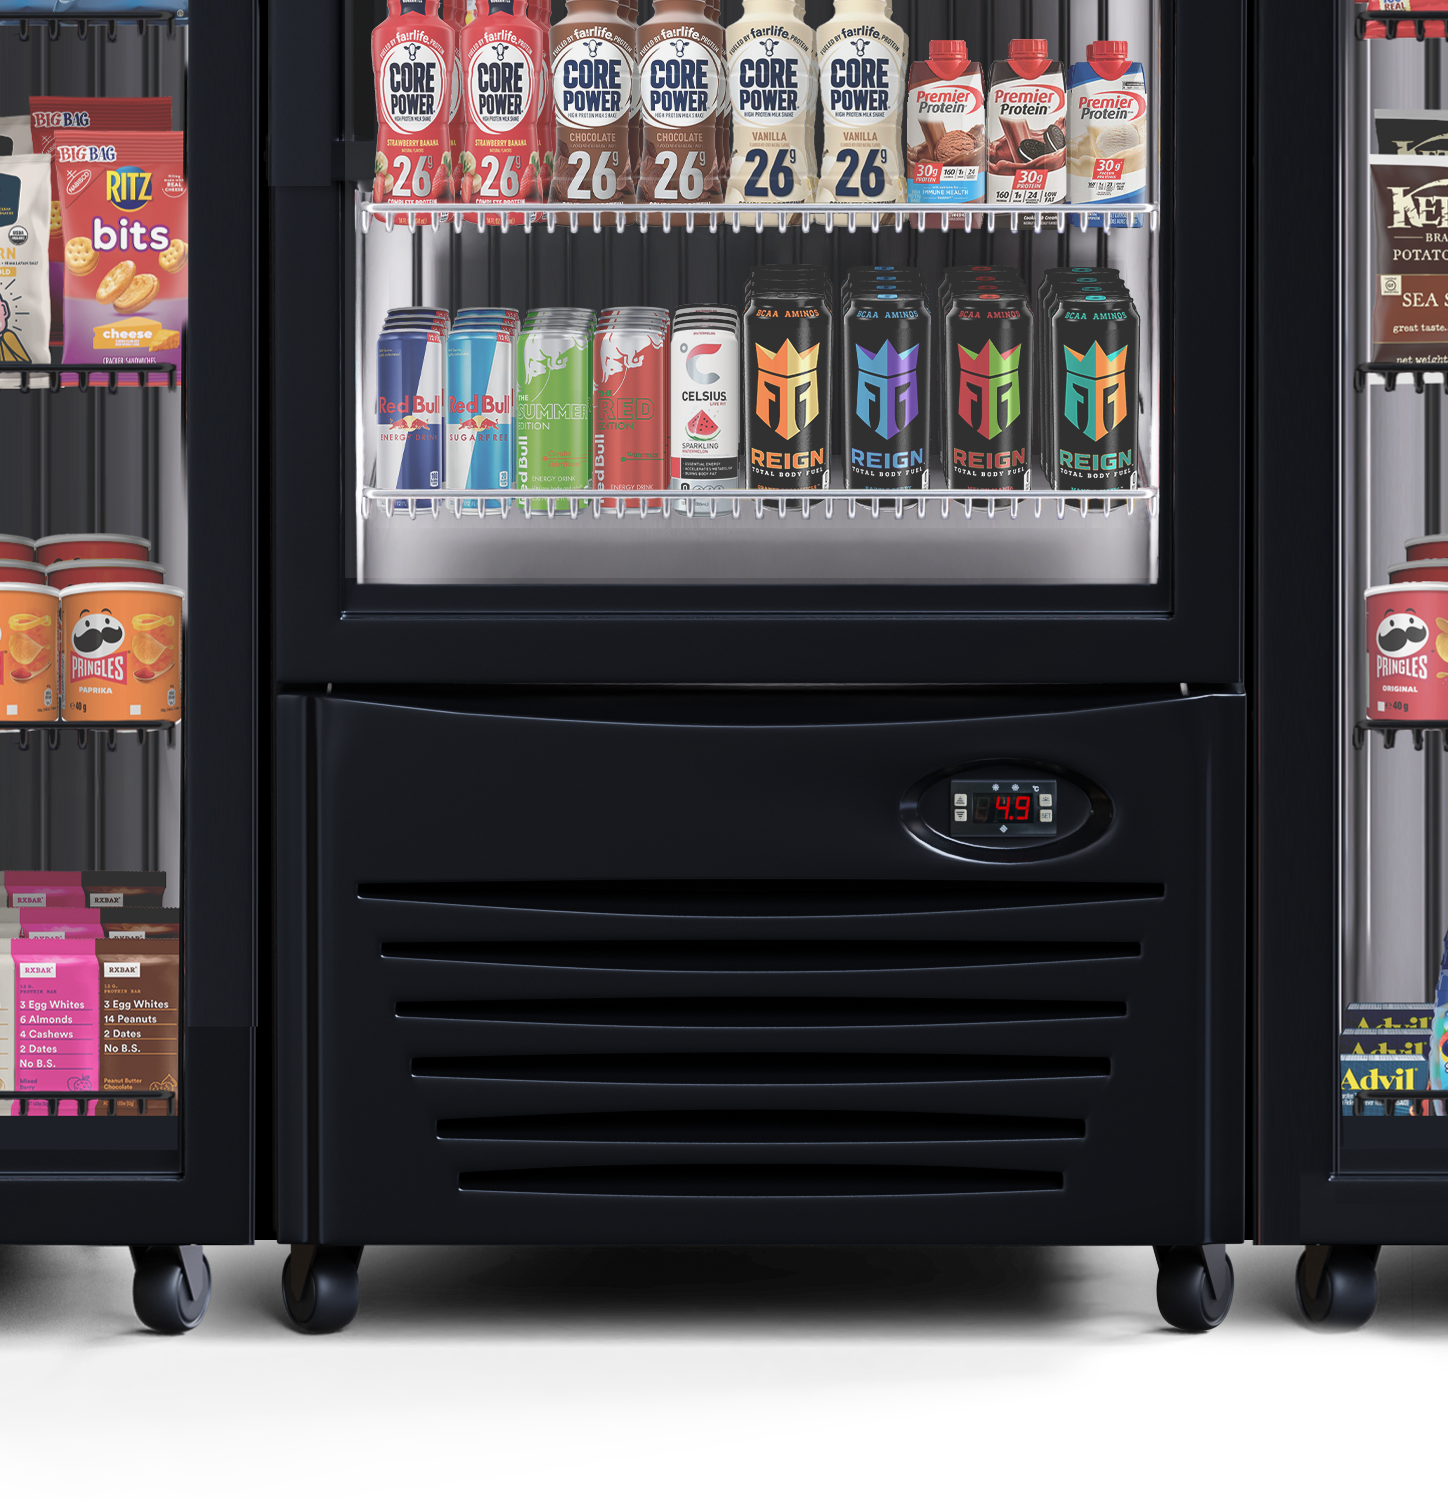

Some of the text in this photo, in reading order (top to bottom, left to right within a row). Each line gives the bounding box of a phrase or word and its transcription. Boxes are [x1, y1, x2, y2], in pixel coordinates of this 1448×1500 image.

[389, 63, 435, 93] CORE
[563, 59, 621, 89] CORE
[740, 59, 798, 88] CORE
[392, 94, 435, 115] POWER
[564, 91, 621, 111] POWER
[740, 90, 798, 110] POWER
[916, 90, 970, 104] Premier
[1079, 96, 1133, 110] Premier
[919, 101, 966, 115] Protein
[1081, 107, 1128, 120] Protein
[570, 133, 616, 142] CHOCOLATE
[752, 132, 787, 141] VANILLA
[58, 146, 116, 161] BIG BAG
[1019, 172, 1042, 184] 30g
[757, 309, 819, 318] BCAA AMINOS
[103, 328, 152, 341] cheese
[379, 395, 440, 414] Red Bull
[449, 395, 509, 414] Red Bull
[682, 391, 727, 402] CELSIUS
[517, 403, 588, 419] SUMMER
[598, 398, 654, 420] RED
[519, 422, 549, 430] EDITION
[598, 422, 633, 430] EDITION
[752, 448, 824, 468] REIGN
[852, 448, 923, 468] REIGN
[1060, 449, 1132, 469] REIGN
[996, 796, 1030, 820] 4.9
